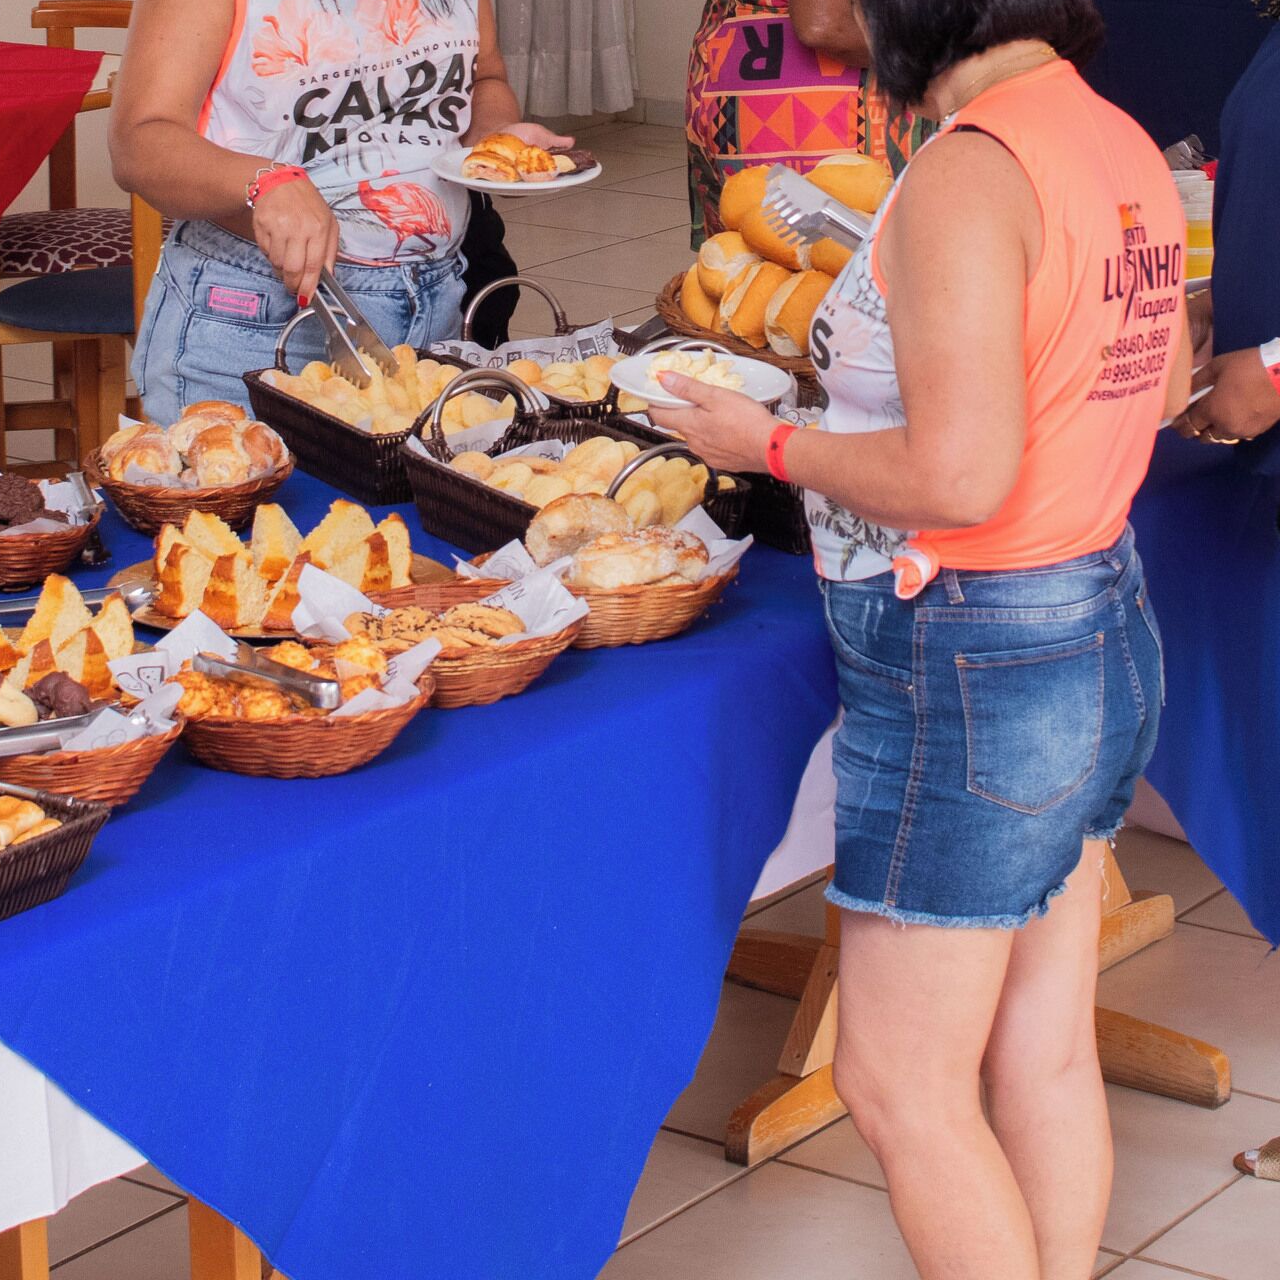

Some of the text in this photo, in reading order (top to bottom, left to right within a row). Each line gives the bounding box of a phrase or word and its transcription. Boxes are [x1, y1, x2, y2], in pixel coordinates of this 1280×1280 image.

[299, 64, 378, 87] SARGENTO
[379, 43, 440, 71] LUISINHO
[357, 130, 431, 147] OIÁS
